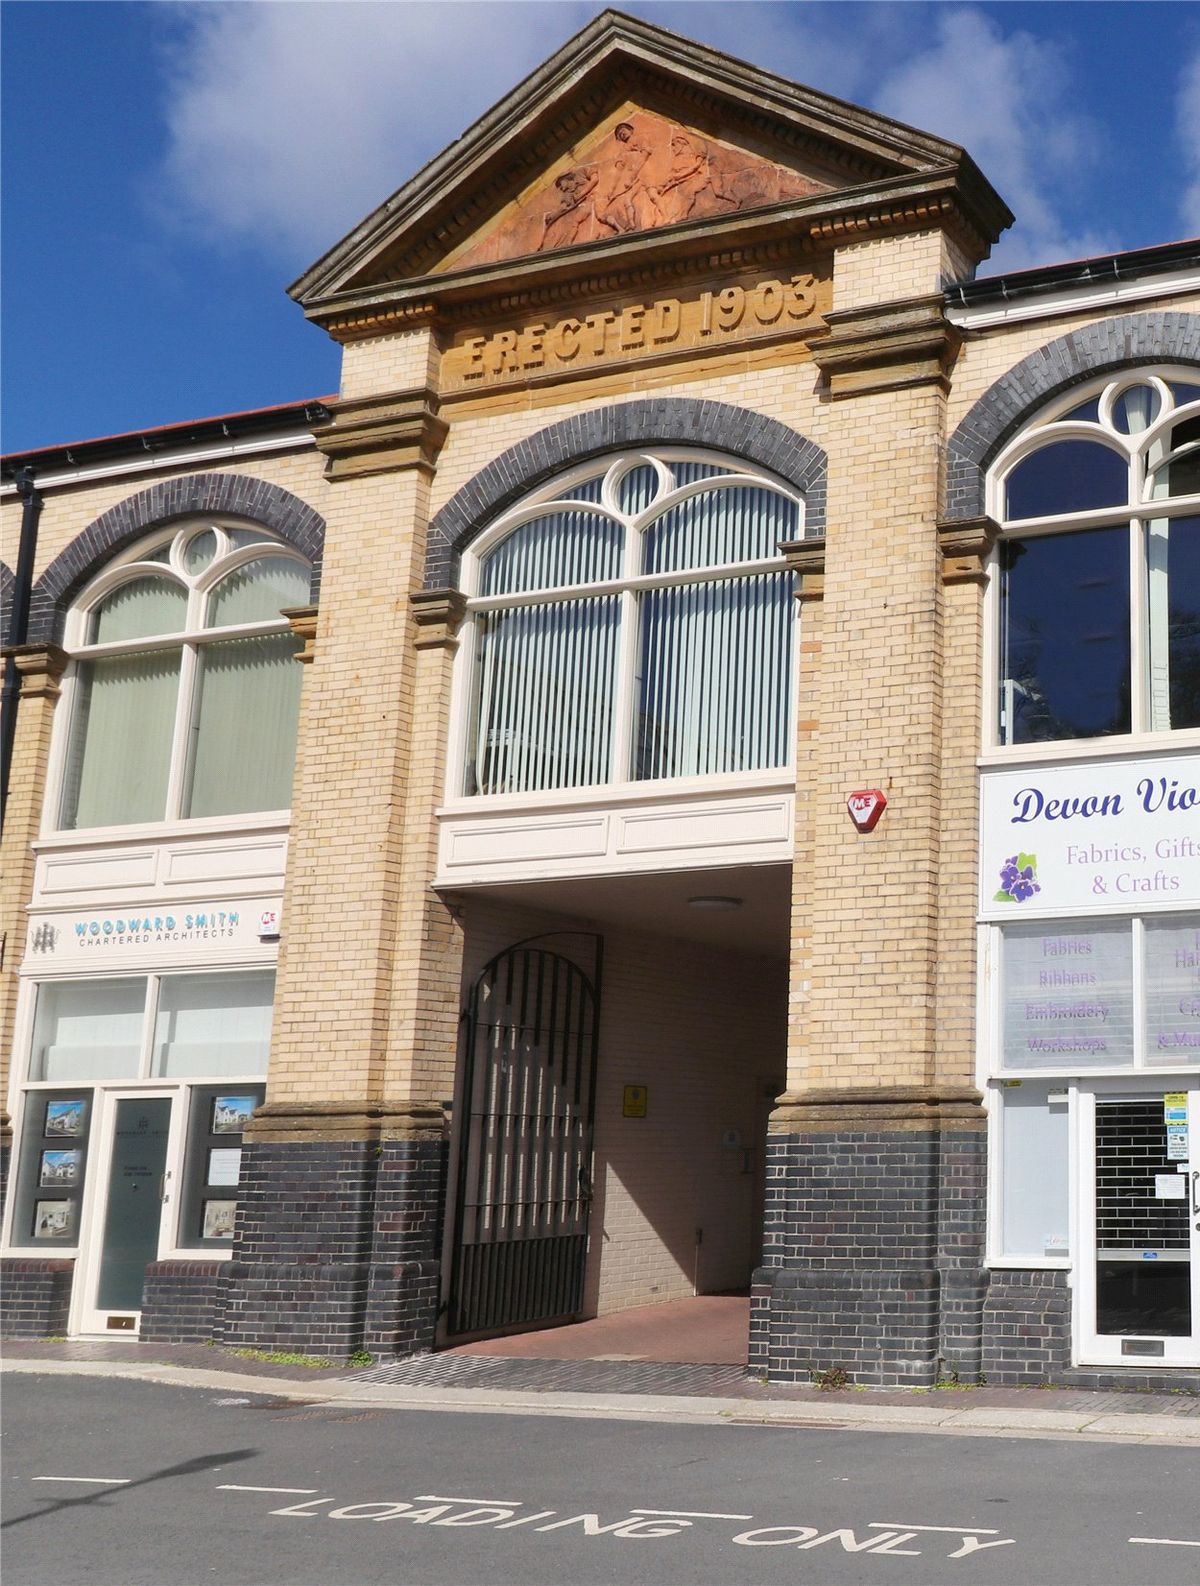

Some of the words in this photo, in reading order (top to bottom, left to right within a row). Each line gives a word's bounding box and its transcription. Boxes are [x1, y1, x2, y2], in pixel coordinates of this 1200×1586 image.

[463, 298, 682, 380] ERECTED
[699, 273, 818, 336] 1903
[1010, 788, 1124, 824] Devon
[1066, 843, 1147, 865] Fabrics,
[1091, 875, 1108, 894] &
[1115, 870, 1180, 893] Crafts
[74, 916, 176, 937] WOODWARD
[185, 911, 240, 930] SMITH
[79, 934, 150, 947] CHARTERED
[156, 928, 234, 941] ARCHITECTS
[267, 1497, 694, 1539] LOADING
[732, 1526, 1016, 1559] ONLY
